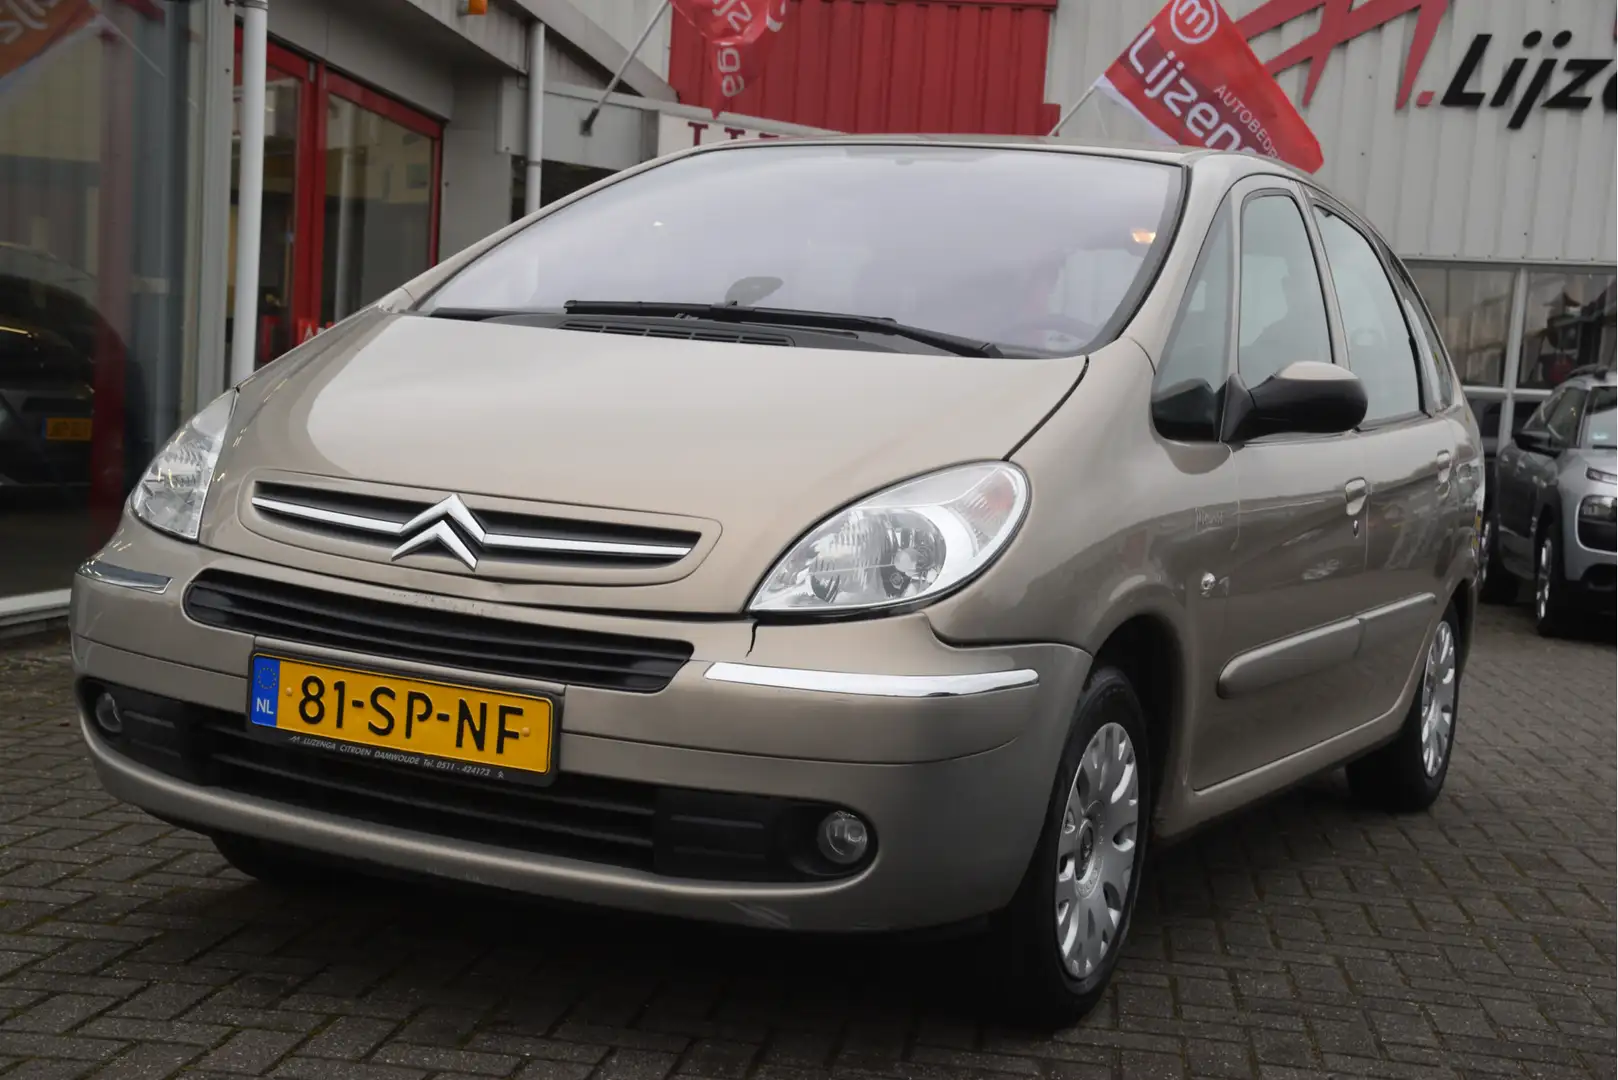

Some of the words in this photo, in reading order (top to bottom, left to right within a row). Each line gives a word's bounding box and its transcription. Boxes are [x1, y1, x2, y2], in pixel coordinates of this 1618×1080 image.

[1128, 26, 1257, 152] Lijzen
[256, 696, 274, 715] NL
[298, 674, 524, 755] 81-SP-NF
